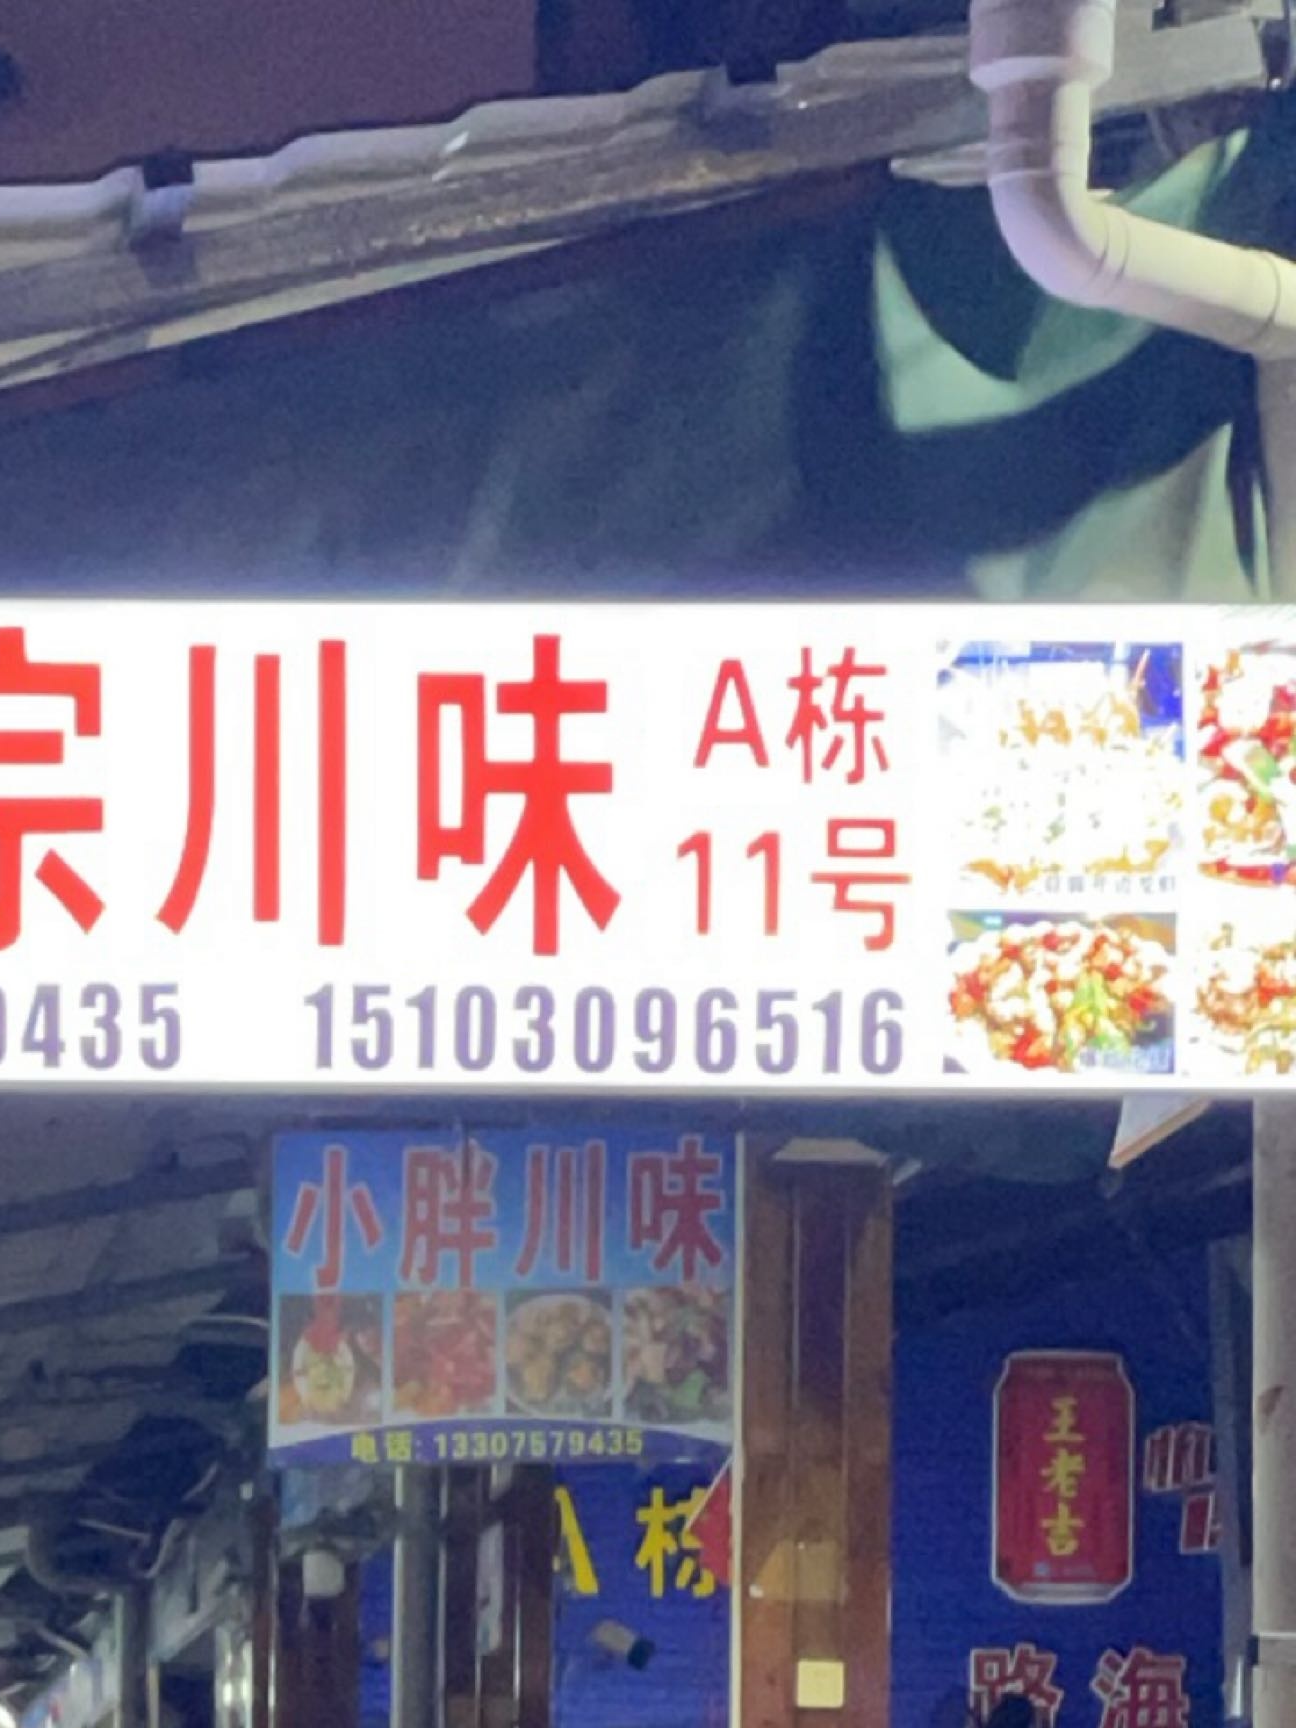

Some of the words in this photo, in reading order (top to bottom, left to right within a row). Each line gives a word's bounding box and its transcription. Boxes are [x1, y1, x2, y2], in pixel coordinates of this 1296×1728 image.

[694, 646, 889, 785] A栋
[676, 818, 912, 952] 11号
[306, 982, 903, 1074] 15103096516
[285, 1133, 724, 1289] 小胖川味
[1040, 1397, 1086, 1556] 王老吉
